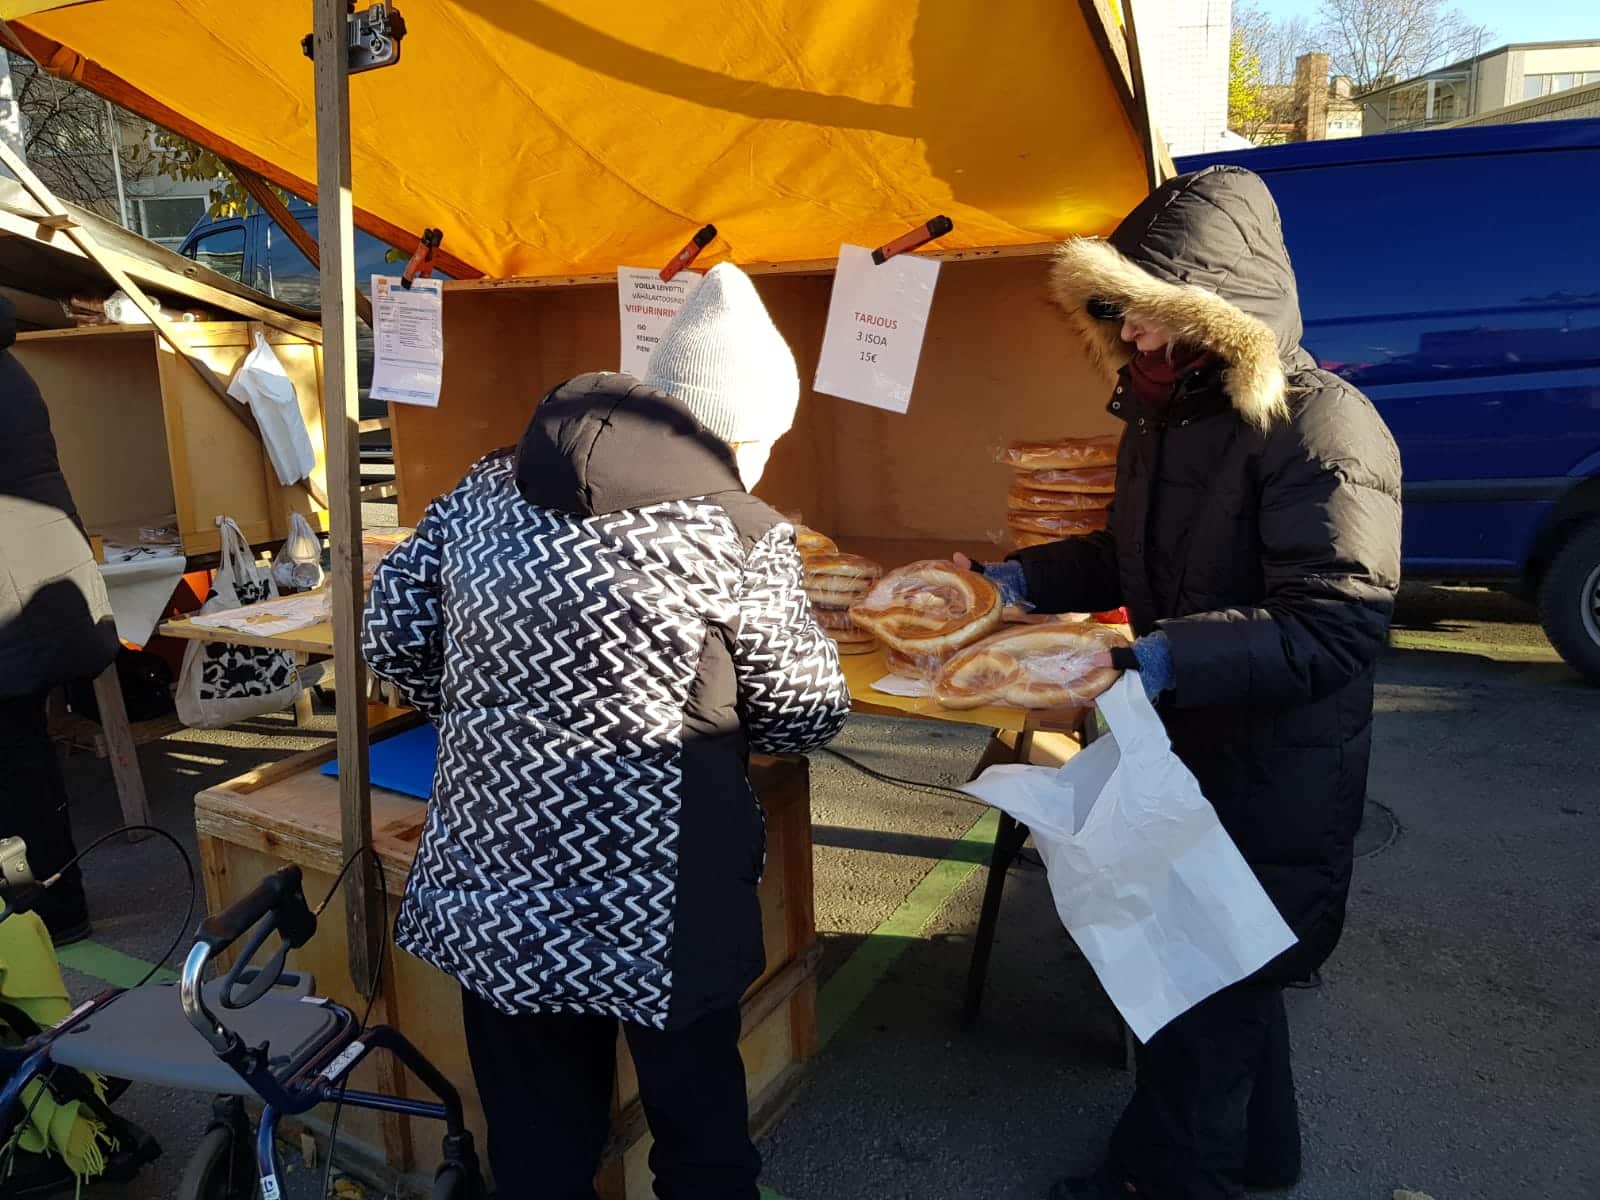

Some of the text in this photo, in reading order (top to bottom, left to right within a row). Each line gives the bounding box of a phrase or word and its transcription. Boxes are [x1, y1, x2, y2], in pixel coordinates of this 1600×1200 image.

[634, 282, 656, 290] VOILLA
[625, 304, 676, 317] VIIPURINRIN
[854, 312, 897, 329] TARJOUS
[636, 335, 661, 344] KESKIKO
[856, 331, 887, 346] 3 ISOA
[859, 351, 878, 363] 15€
